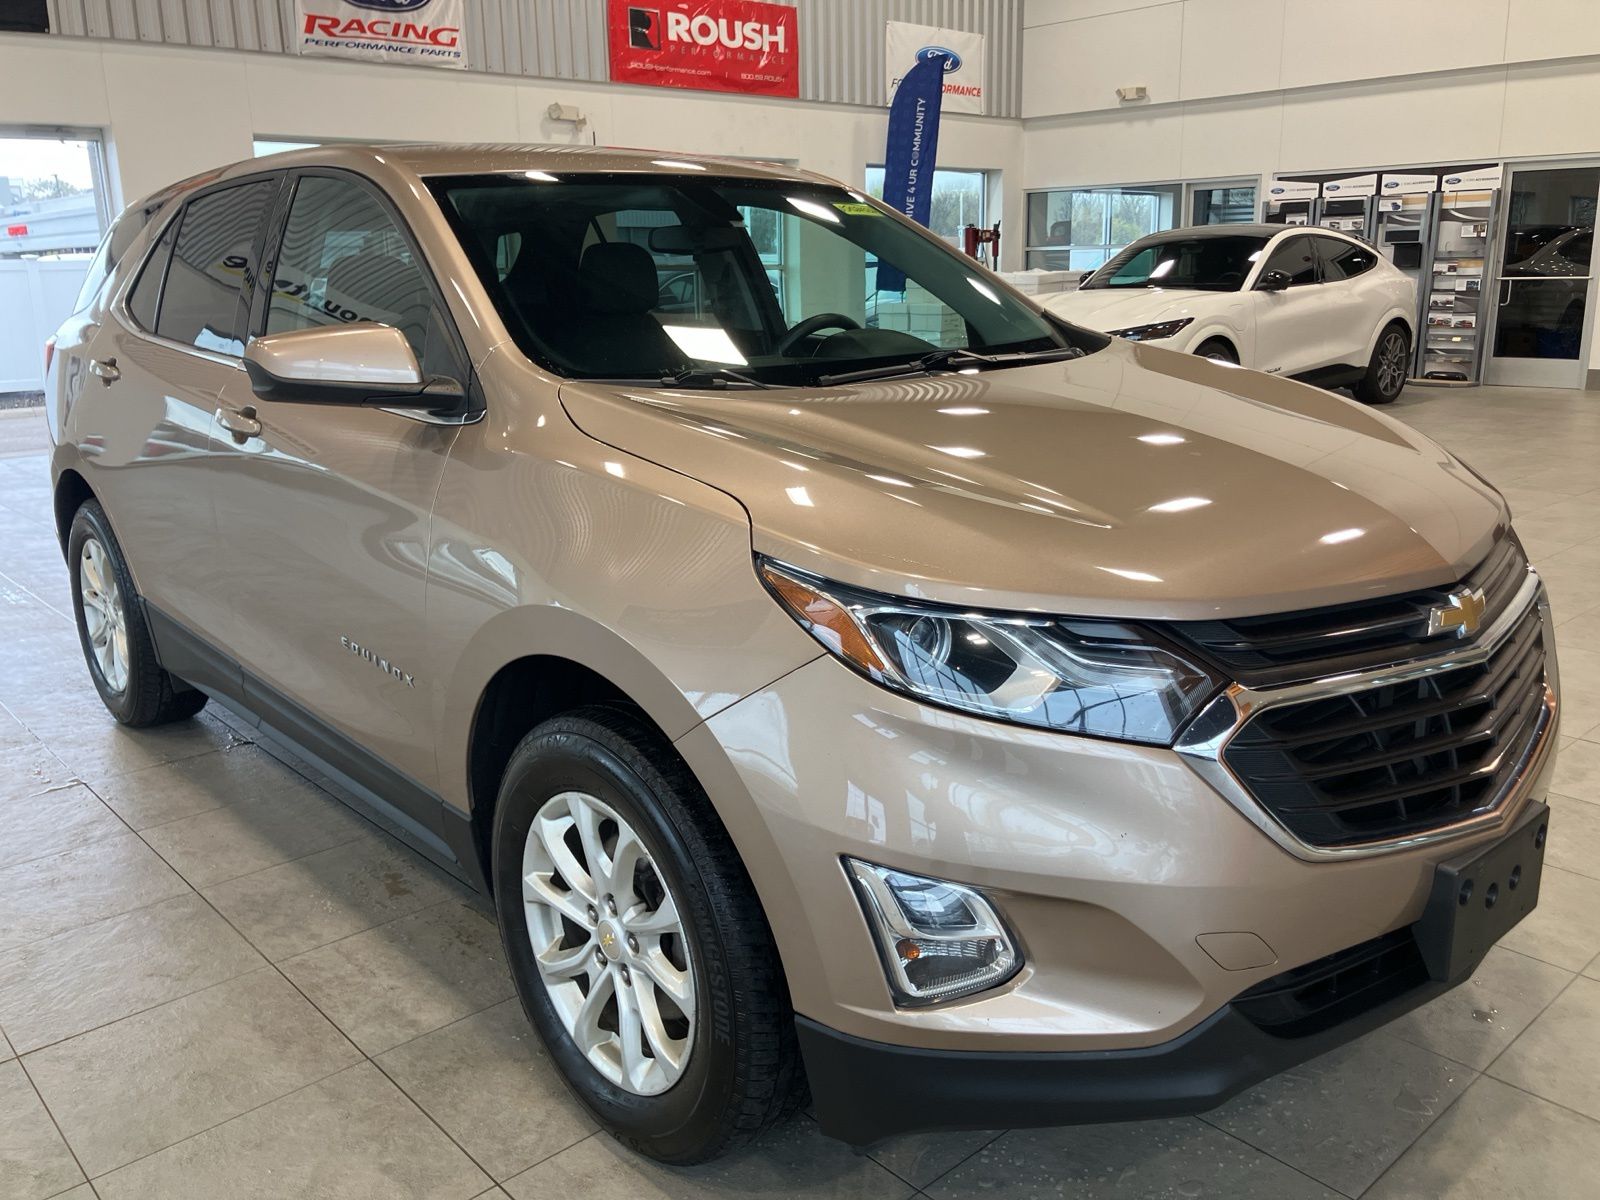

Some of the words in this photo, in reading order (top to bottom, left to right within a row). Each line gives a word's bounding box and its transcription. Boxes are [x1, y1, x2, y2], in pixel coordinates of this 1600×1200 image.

[304, 13, 459, 47] RACING
[667, 12, 785, 53] ROUSH
[304, 38, 416, 54] PERFORMANCE
[420, 48, 462, 58] PARTS
[670, 45, 784, 65] PERFORMANCE
[942, 84, 981, 97] ORMANCE
[910, 98, 926, 166] COMMUNITY
[908, 169, 918, 184] UR
[908, 186, 915, 194] 4
[905, 196, 915, 218] RIVE
[341, 636, 416, 689] EQUINOX
[694, 900, 730, 1047] IDGESTONE
